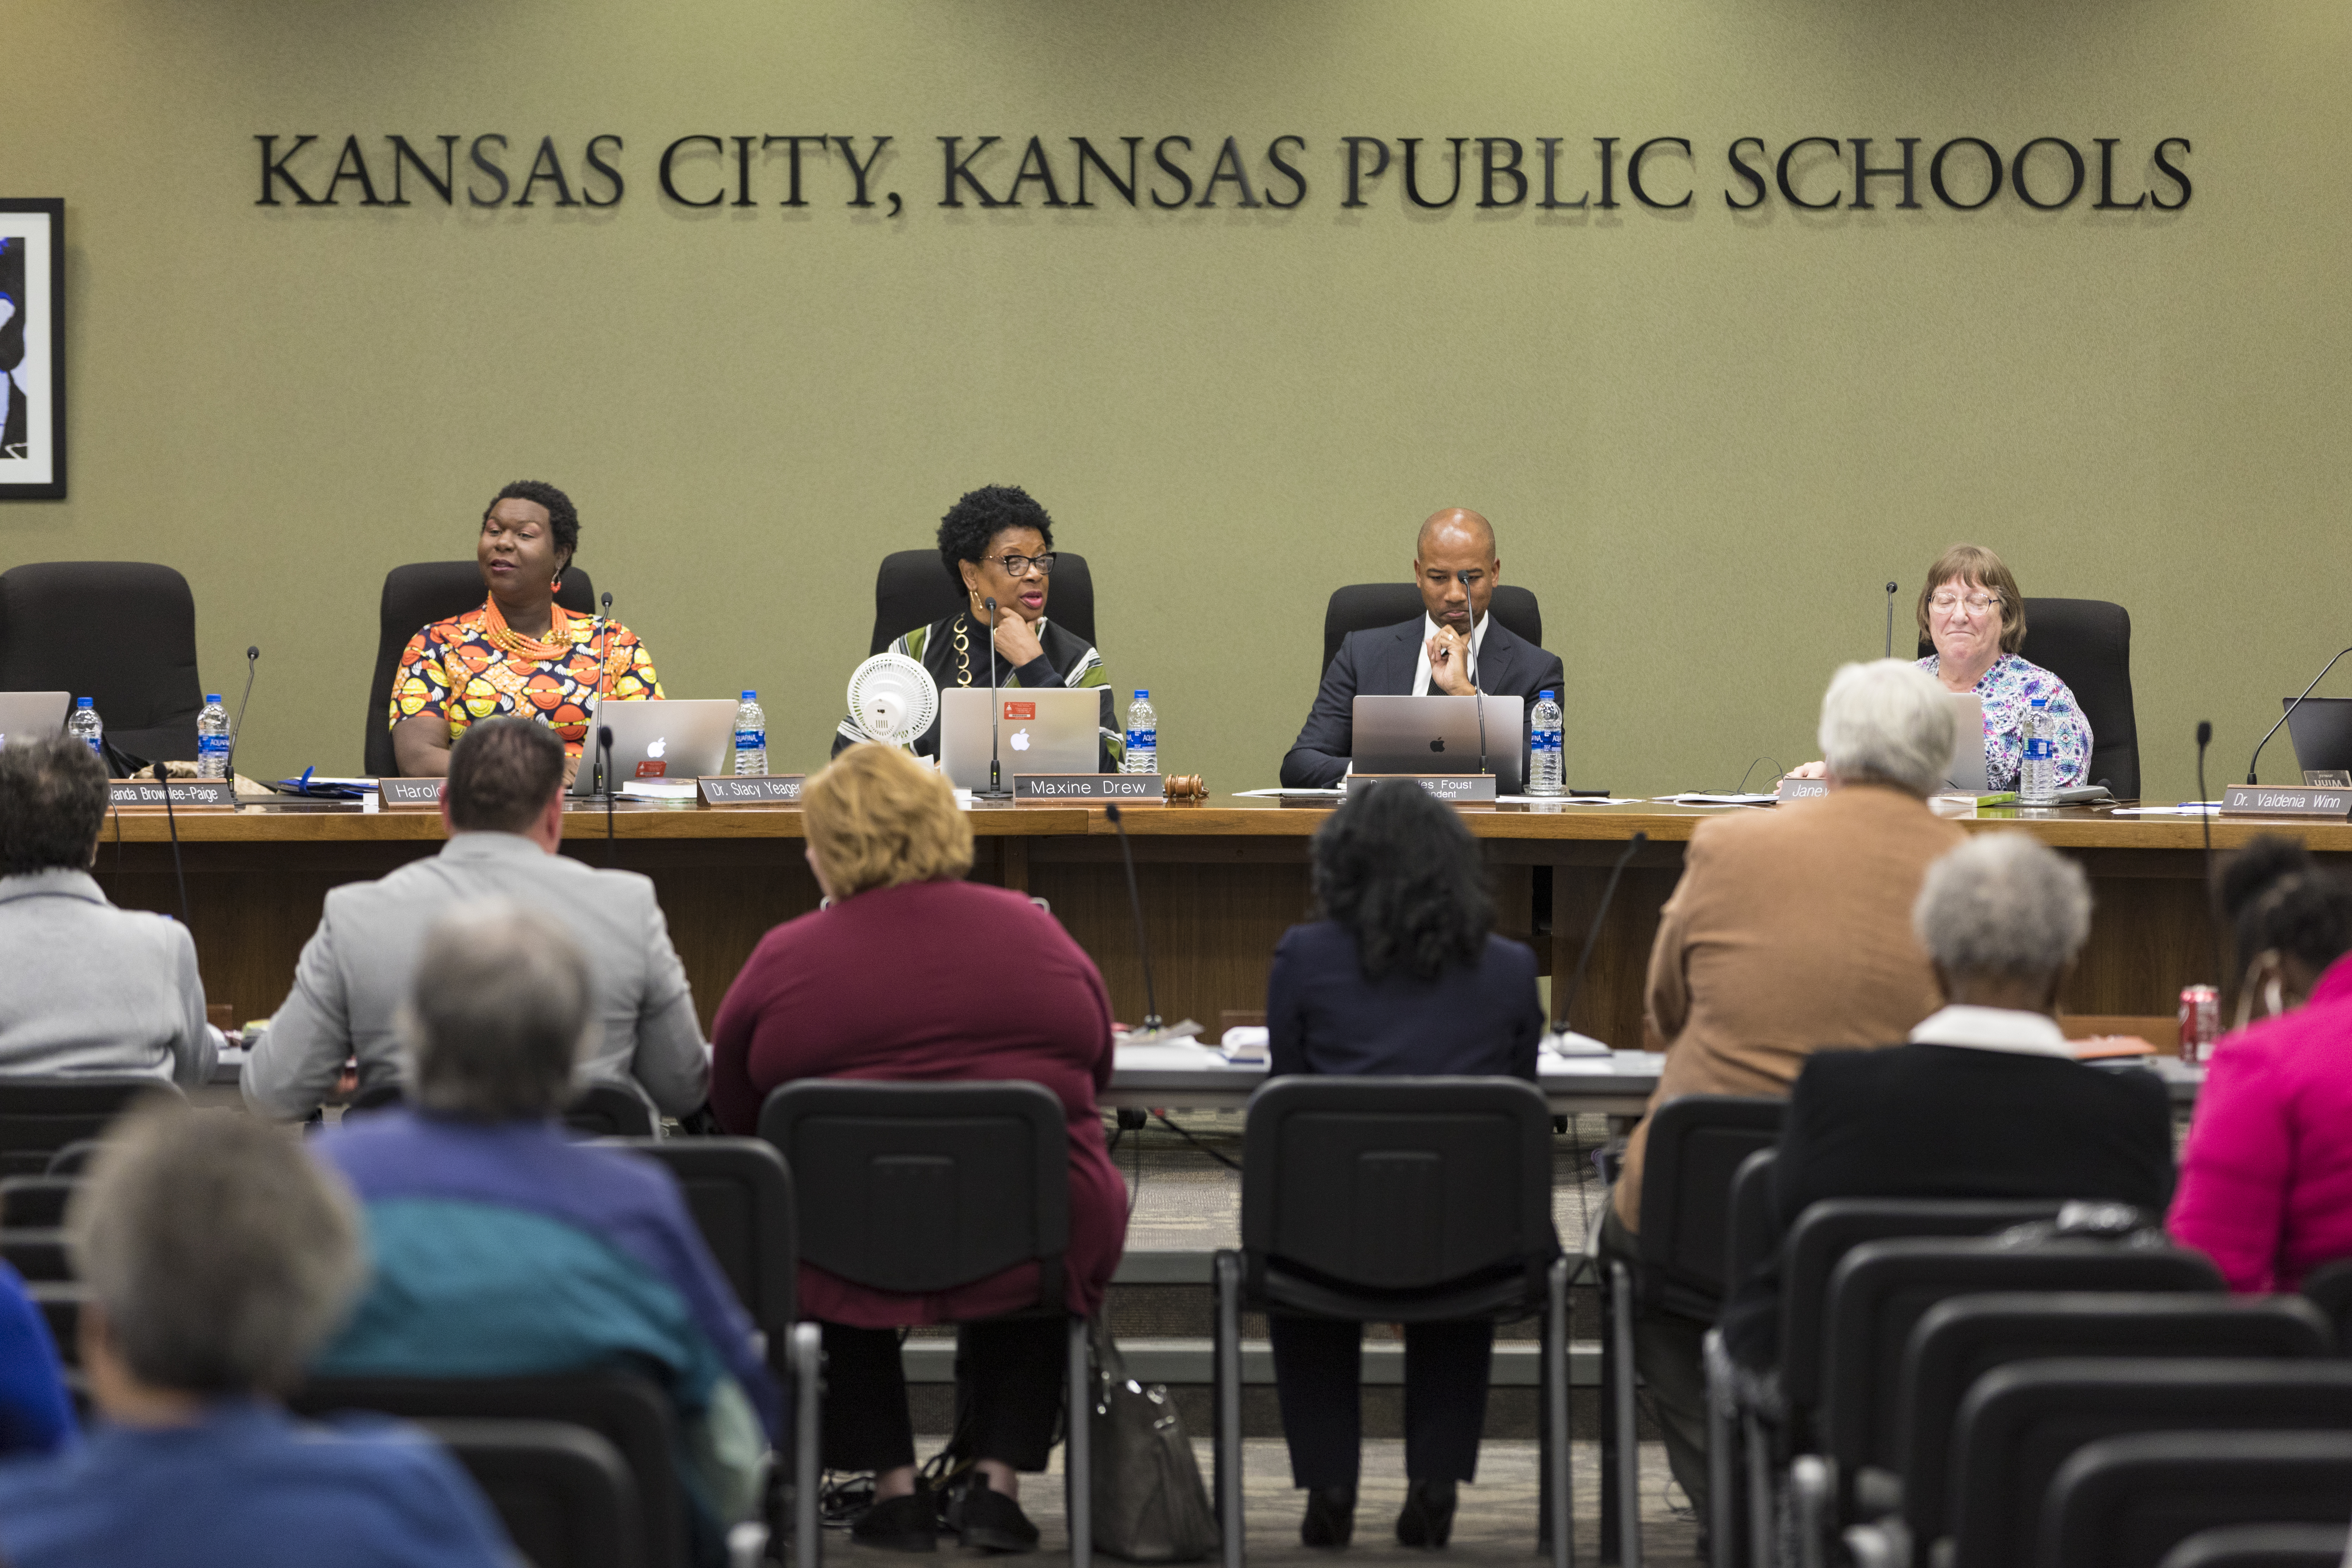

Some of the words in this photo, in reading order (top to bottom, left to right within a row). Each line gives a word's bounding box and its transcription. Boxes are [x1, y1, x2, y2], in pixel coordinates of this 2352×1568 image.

[252, 134, 625, 208] KANSAS
[659, 134, 903, 218] CITY,
[936, 135, 1308, 209] KANSAS
[1340, 136, 1696, 209] PUBLIC
[1724, 136, 2192, 209] SCHOOLS
[711, 783, 728, 796] Dr.
[731, 782, 761, 797] Stacy
[764, 782, 801, 797] Yeager
[1031, 781, 1091, 794] Maxine
[1103, 780, 1146, 794] Drew
[1441, 780, 1472, 789] Foust
[2233, 793, 2248, 806] Dr.
[2258, 793, 2305, 807] Valdenia
[2313, 794, 2340, 808] Winn
